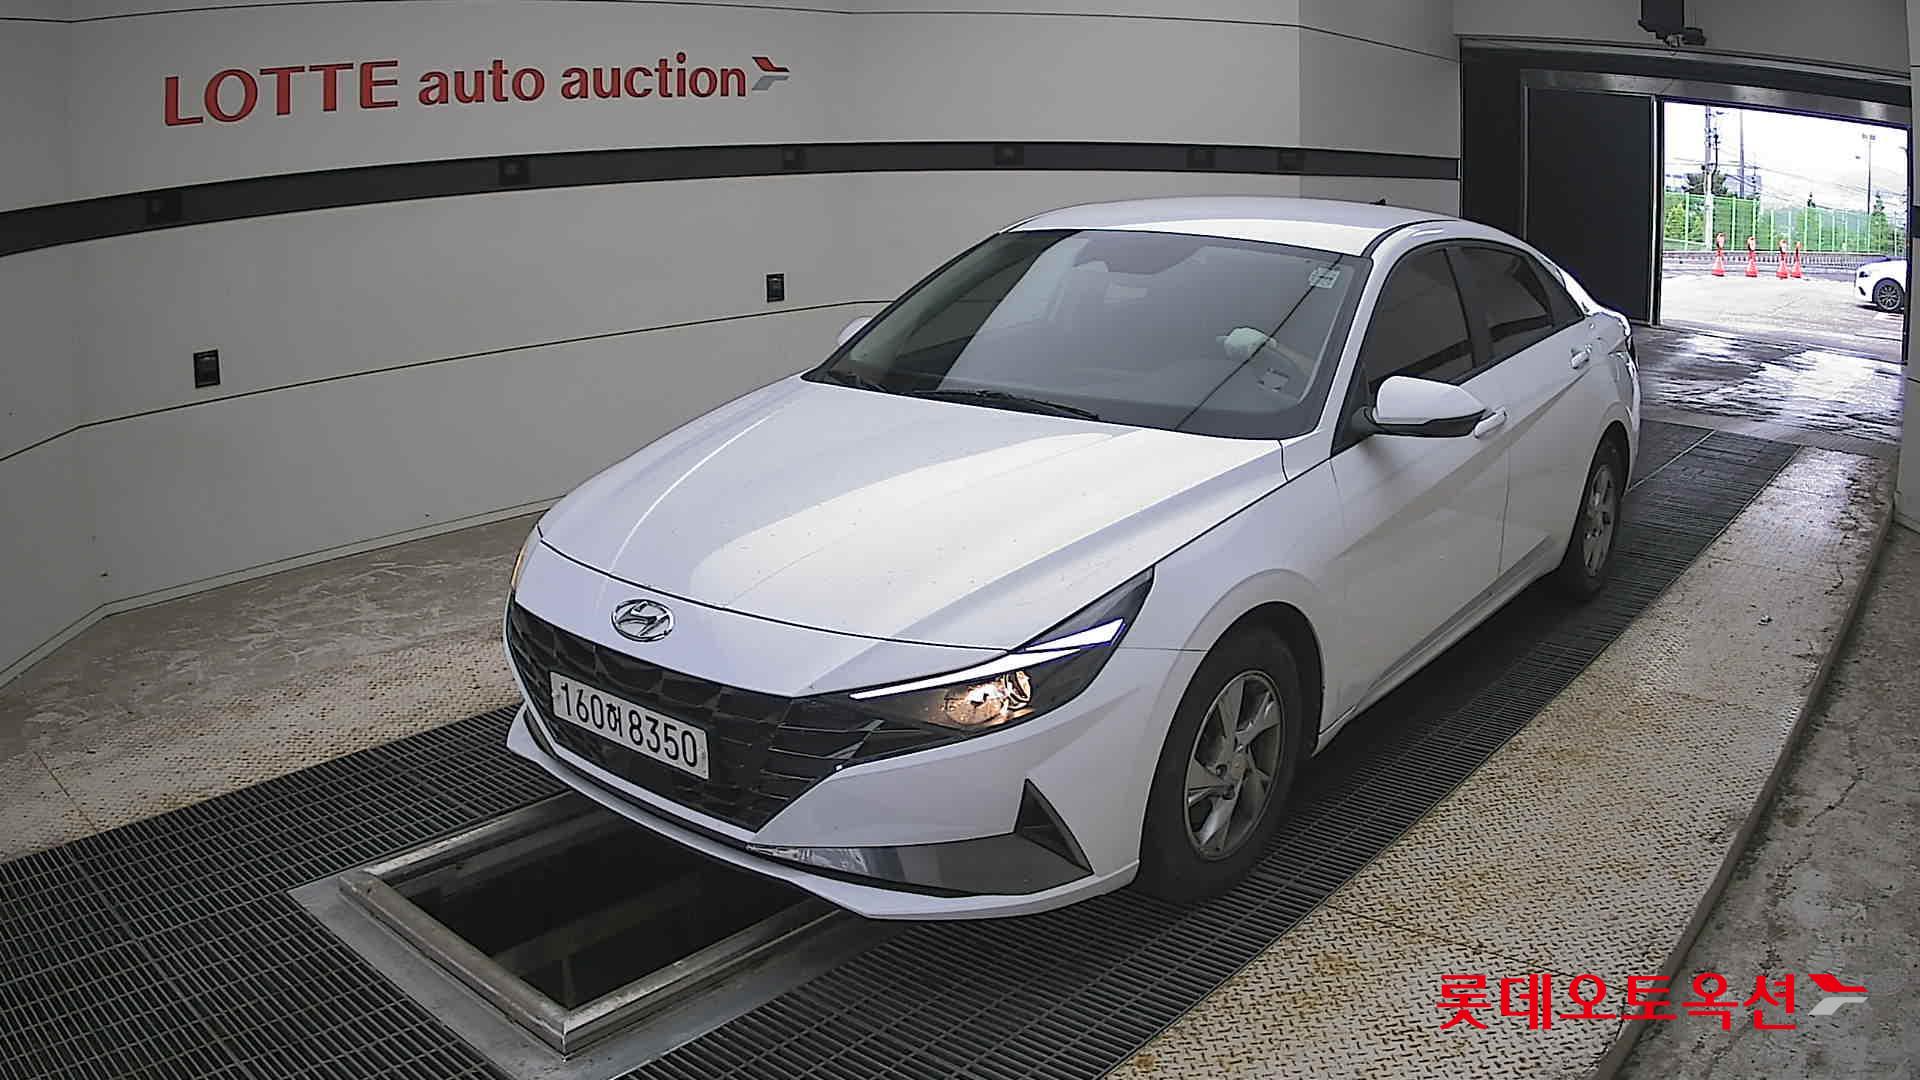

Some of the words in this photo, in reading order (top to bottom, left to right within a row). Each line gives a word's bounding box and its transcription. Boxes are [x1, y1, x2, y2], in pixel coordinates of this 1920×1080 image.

[164, 59, 399, 126] LOTTE
[418, 59, 545, 105] auto
[560, 52, 748, 98] auction
[560, 682, 698, 767] 160허8350
